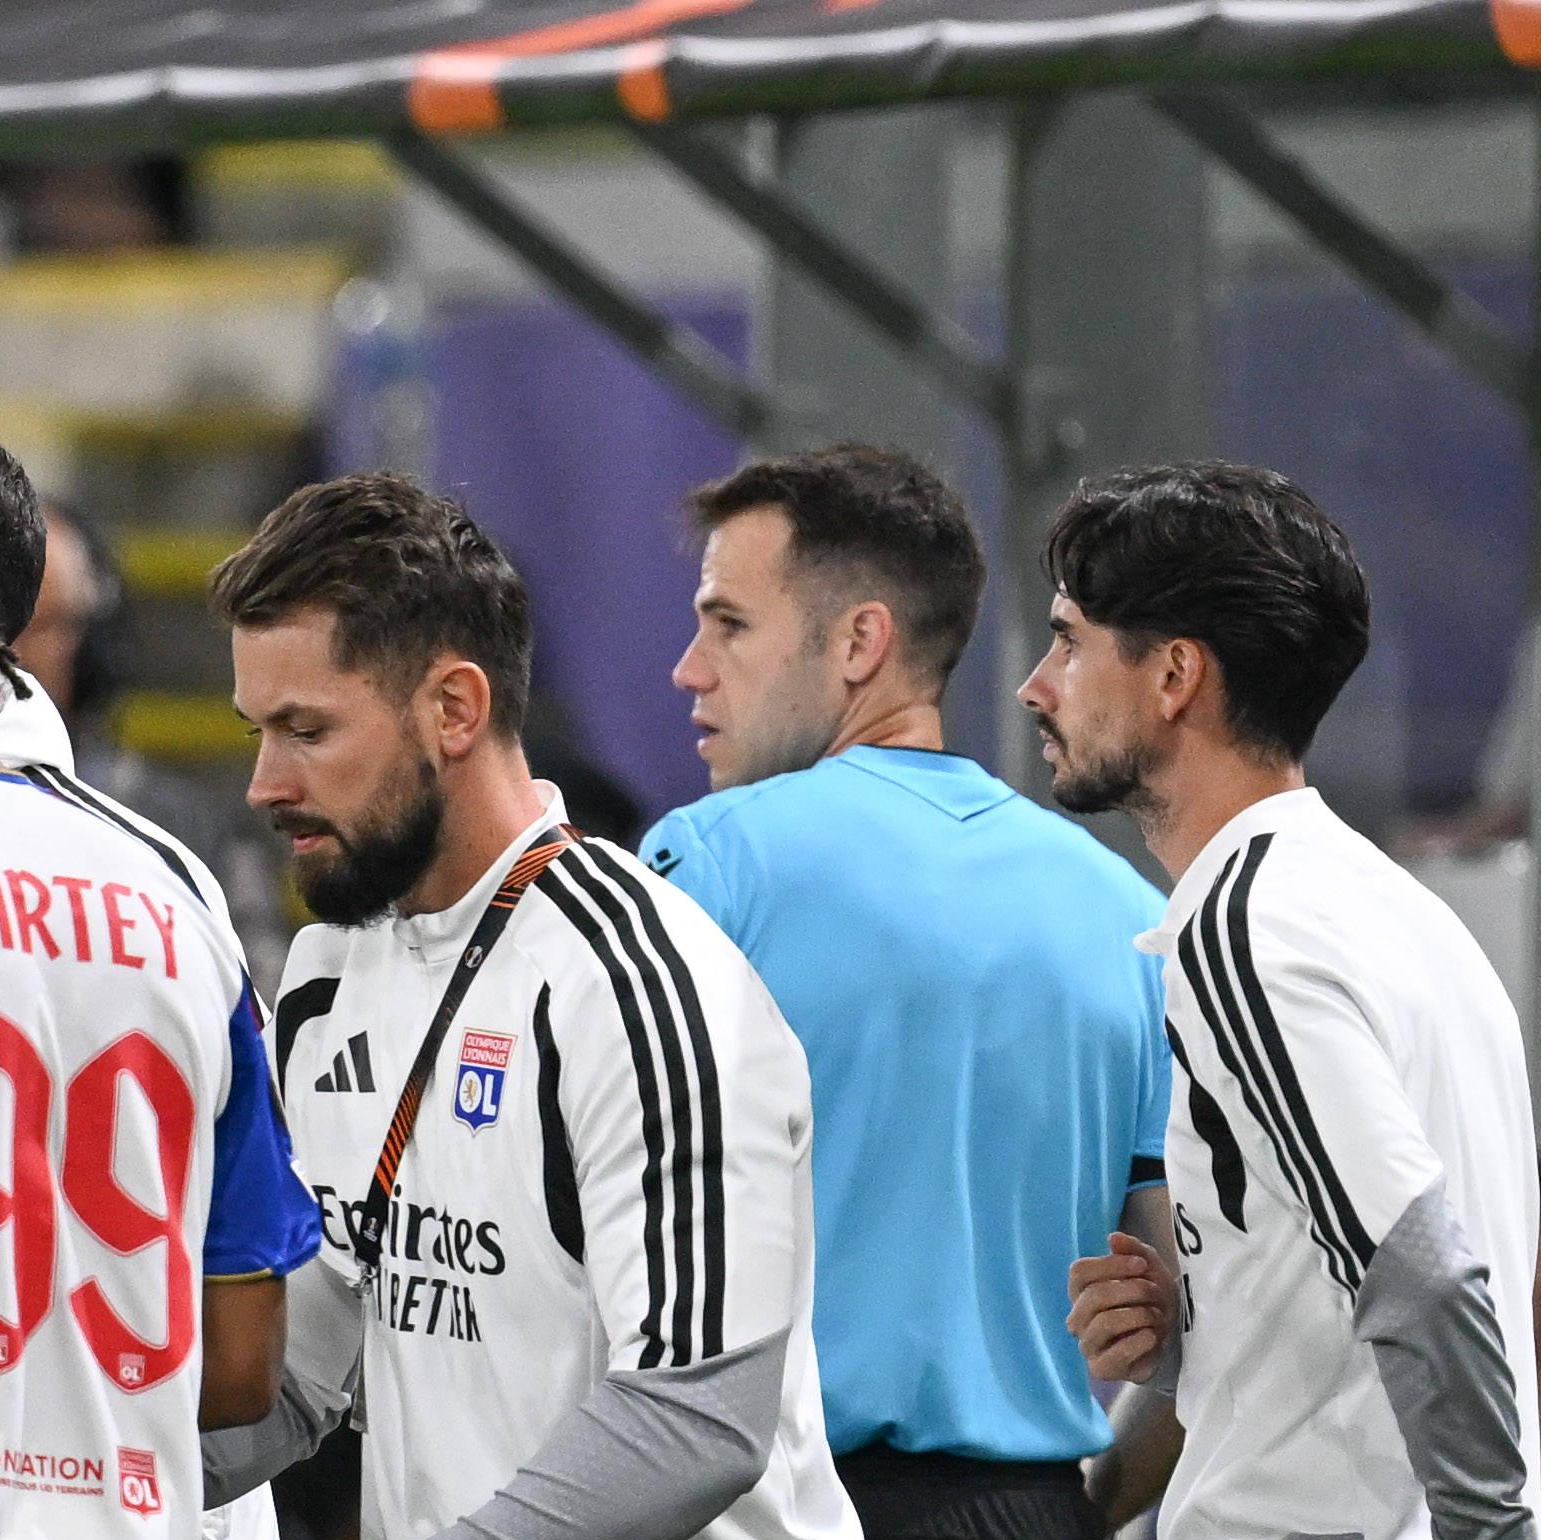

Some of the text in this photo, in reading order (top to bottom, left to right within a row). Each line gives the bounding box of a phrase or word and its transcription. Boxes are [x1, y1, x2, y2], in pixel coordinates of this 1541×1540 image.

[466, 1035, 511, 1052] OLYMPIQUE
[463, 1047, 508, 1065] LYONNAIS
[459, 1070, 497, 1116] OL
[123, 1476, 158, 1507] OL
